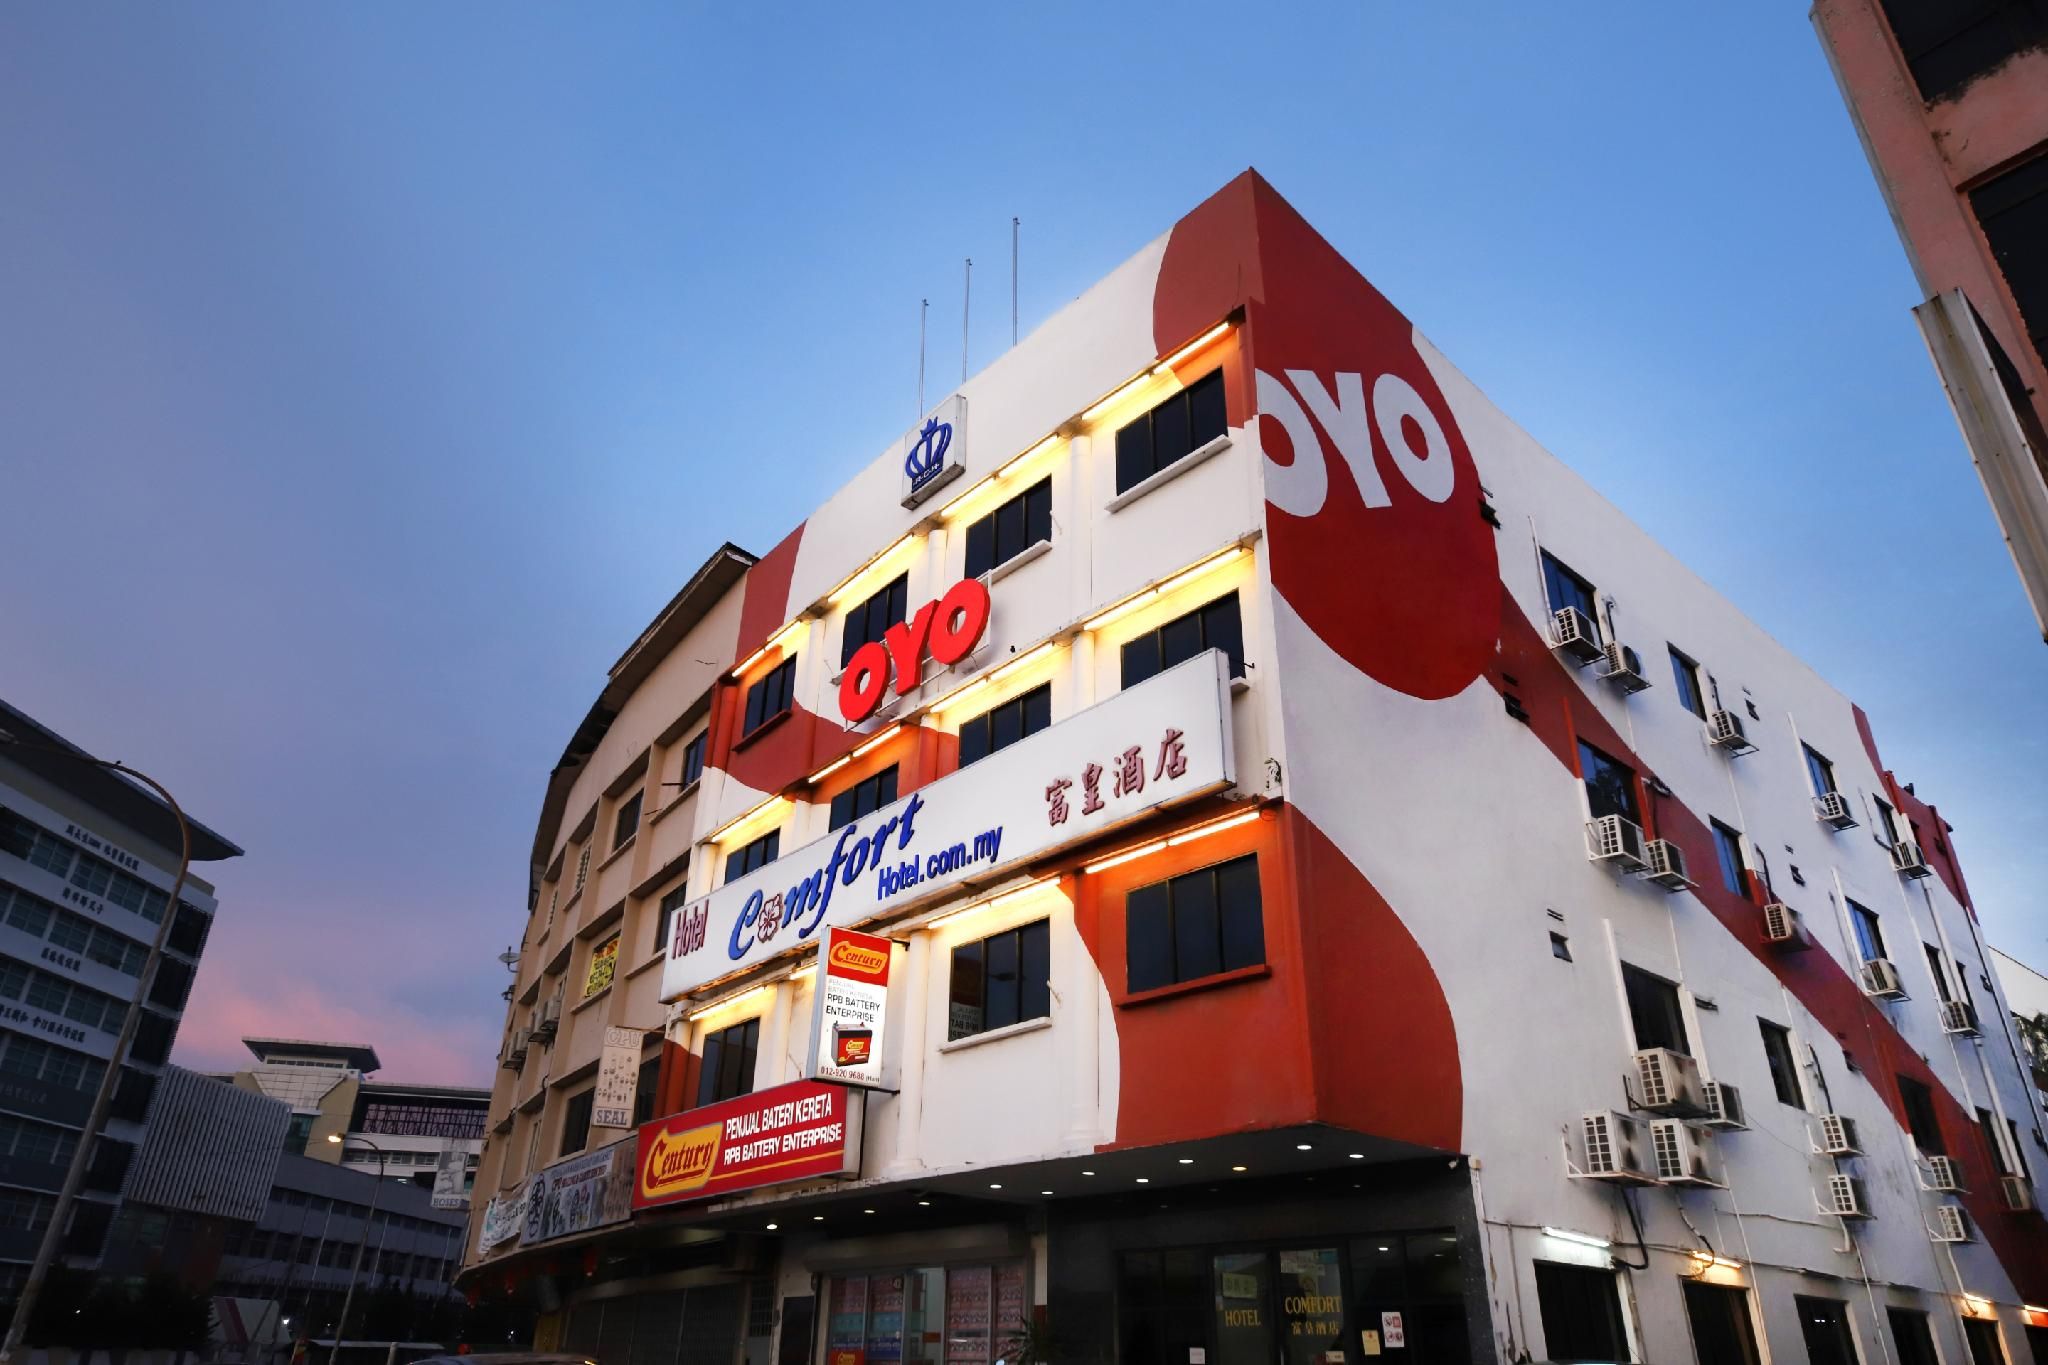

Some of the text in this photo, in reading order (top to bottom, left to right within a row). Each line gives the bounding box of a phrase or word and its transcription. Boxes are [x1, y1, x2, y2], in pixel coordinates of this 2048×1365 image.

[1254, 368, 1455, 517] OYO
[839, 578, 991, 722] OYO
[1045, 729, 1187, 827] 富皇酒店
[877, 826, 1003, 901] Hotel.com.my
[672, 899, 710, 960] Hotel
[833, 944, 883, 968] Century
[825, 1005, 875, 1022] ENTERPRISE
[827, 993, 880, 1012] RPB BATTERY
[596, 1109, 627, 1125] SEAL
[725, 1092, 832, 1141] PENJUAL BATERI KERETA
[645, 1137, 716, 1190] Century
[723, 1122, 843, 1166] RPB BATTERY ENTERPRISE
[1224, 1296, 1342, 1328] HOTEL COMFORT
